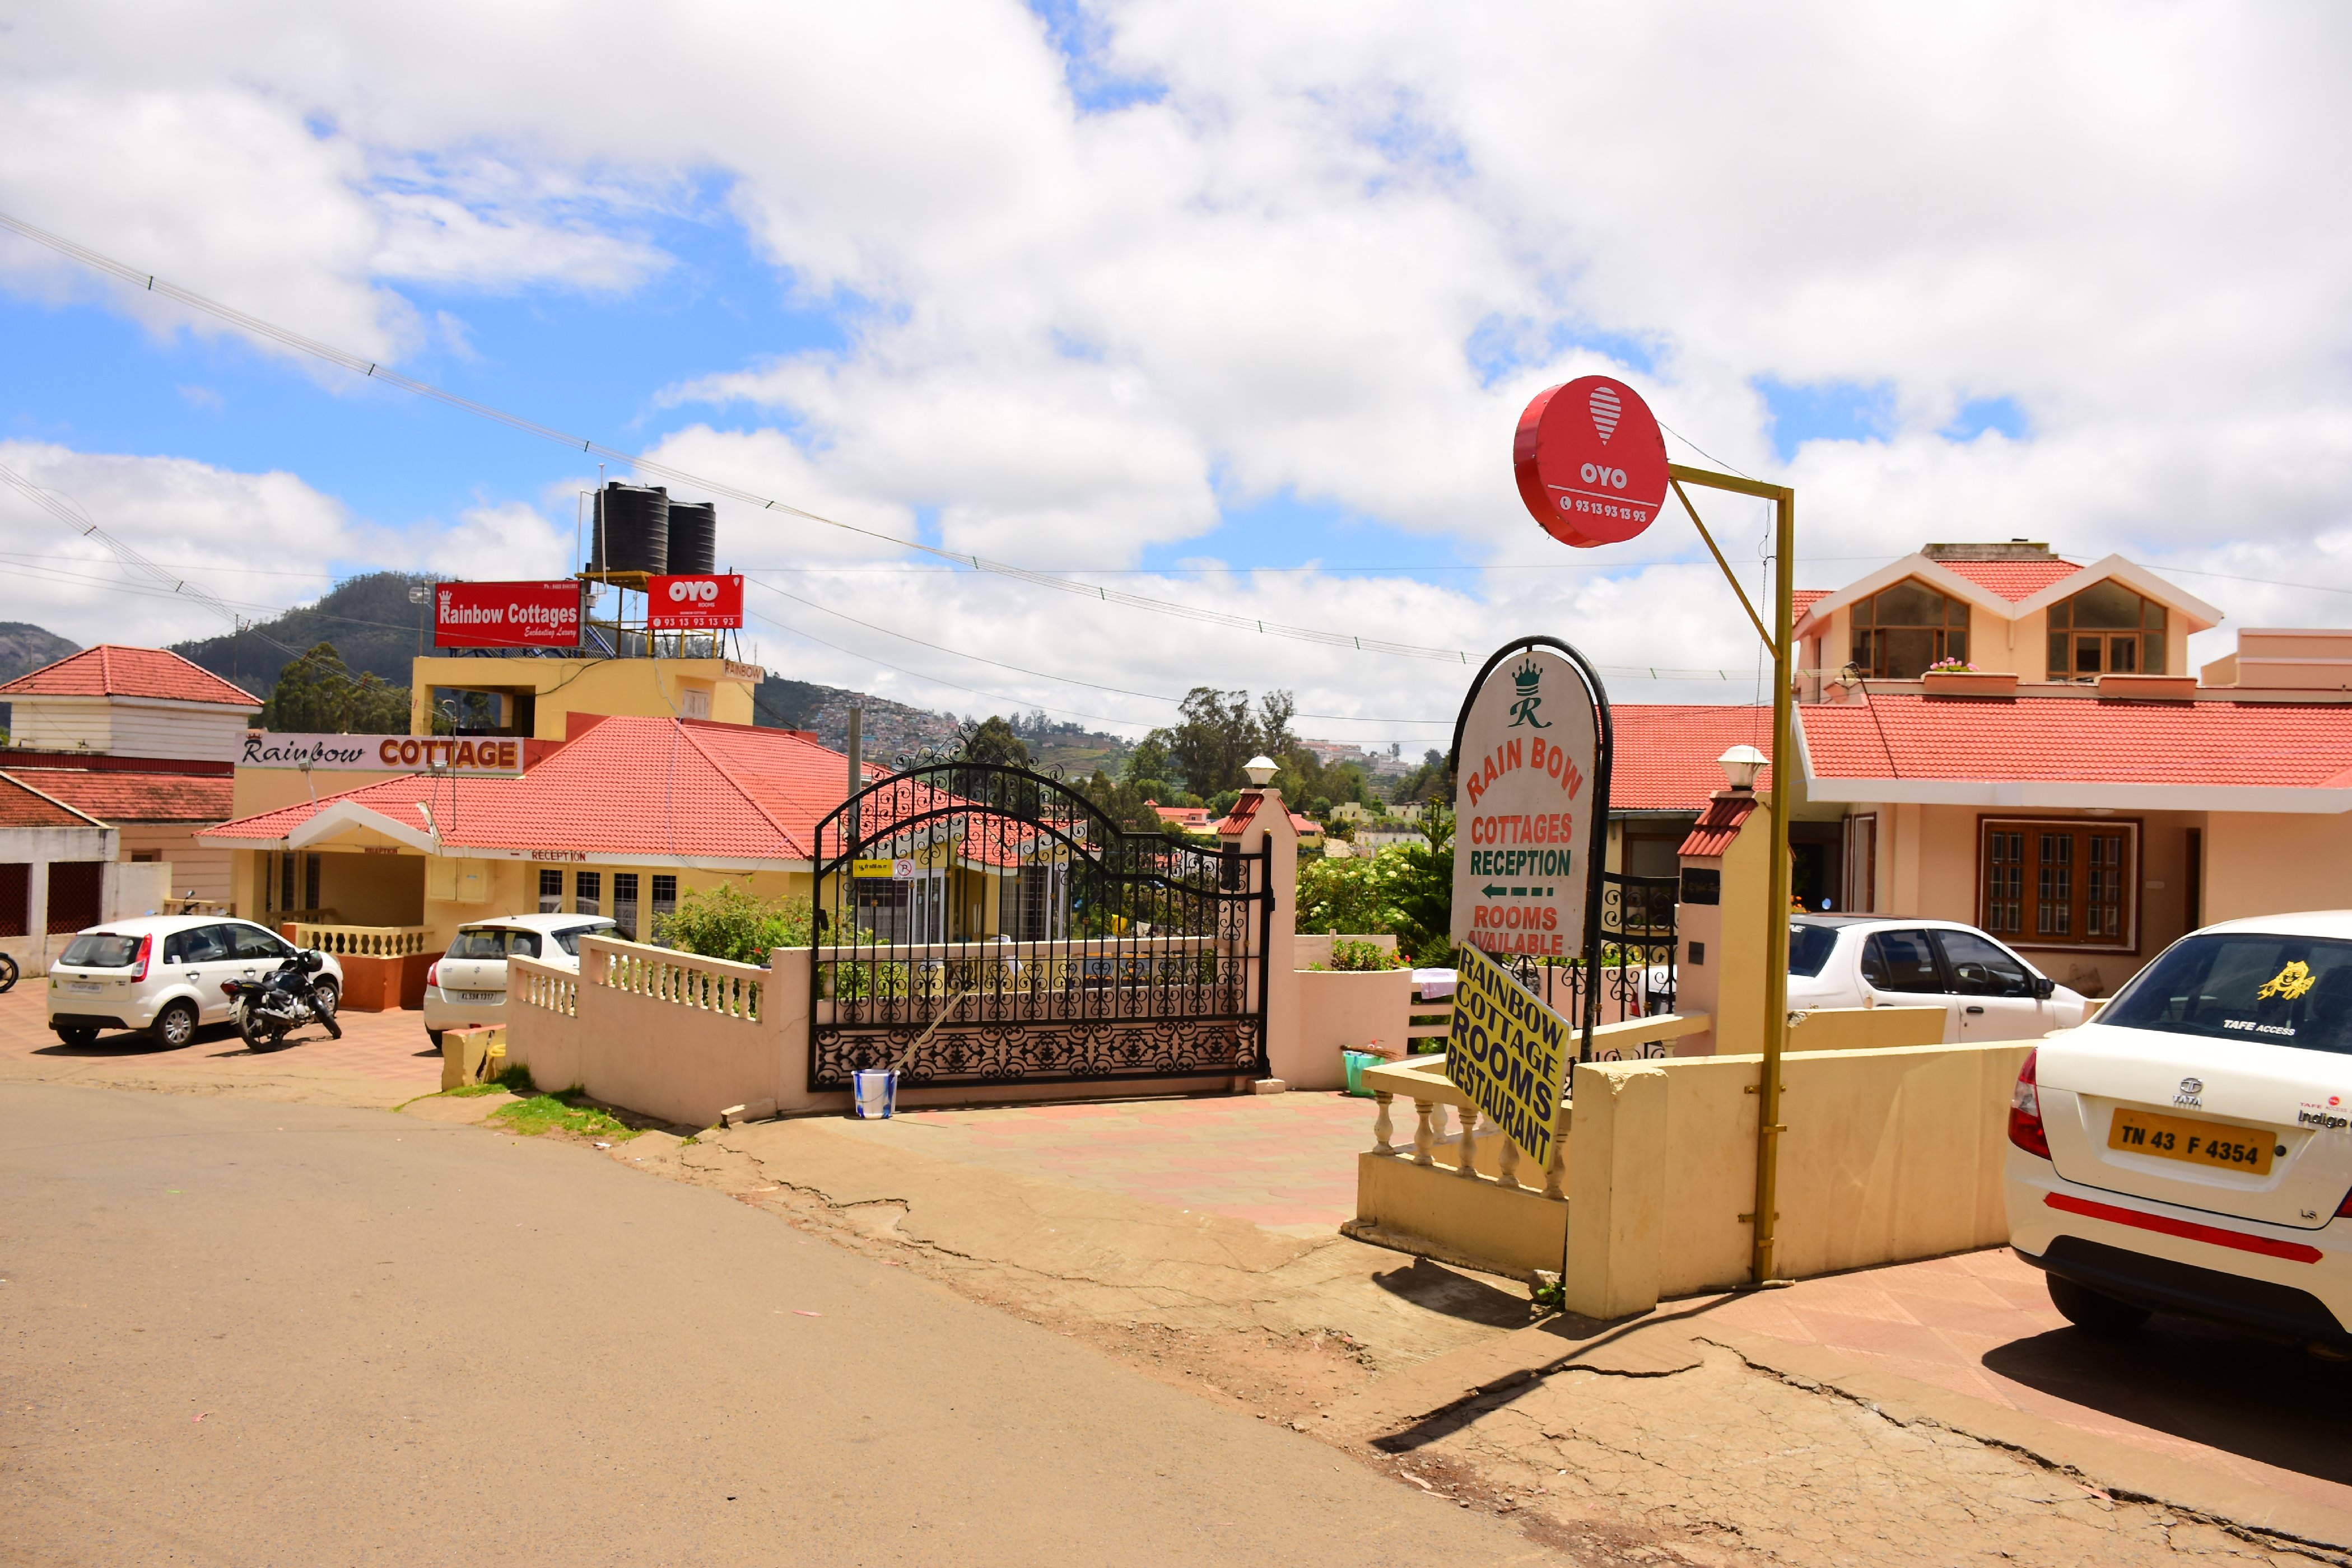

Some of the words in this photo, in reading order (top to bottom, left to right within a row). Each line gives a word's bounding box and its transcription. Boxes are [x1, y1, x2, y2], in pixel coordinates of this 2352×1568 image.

[1580, 463, 1627, 489] OYO
[1576, 500, 1589, 512] 93
[1591, 503, 1602, 515] 13
[1604, 505, 1618, 517] 93
[1620, 507, 1631, 520] 13
[1633, 510, 1646, 522] 93
[669, 581, 719, 601] OYO
[440, 604, 504, 624] Rainbow
[508, 603, 577, 628] Cottages
[524, 626, 555, 638] Enchanting
[556, 627, 577, 638] Luxury
[725, 661, 761, 679] RAINBOW
[242, 739, 366, 763] Rainbow
[379, 739, 518, 769] COTTAGE
[1466, 737, 1522, 808] RAIN
[1531, 737, 1583, 801] BOW
[1471, 813, 1572, 844] COTTAGES
[532, 851, 586, 862] RECEPTION
[1470, 849, 1571, 876] RECEPTION
[1474, 906, 1557, 931] ROOMS
[1468, 931, 1563, 955] AVAILABLE
[1460, 946, 1564, 1051] RAINBOW
[1457, 981, 1558, 1087] COTTAGE
[2223, 1019, 2256, 1031] TAFE
[2256, 1025, 2295, 1036] ACCESS
[1451, 1006, 1553, 1122] ROOMS
[1445, 1042, 1550, 1166] RESTAURANT
[2173, 1094, 2202, 1107] TATA
[2298, 1109, 2347, 1129] Indigo
[2122, 1126, 2146, 1145] TN
[2150, 1131, 2176, 1150] 43
[2187, 1137, 2201, 1154] F
[2205, 1140, 2258, 1165] 4354
